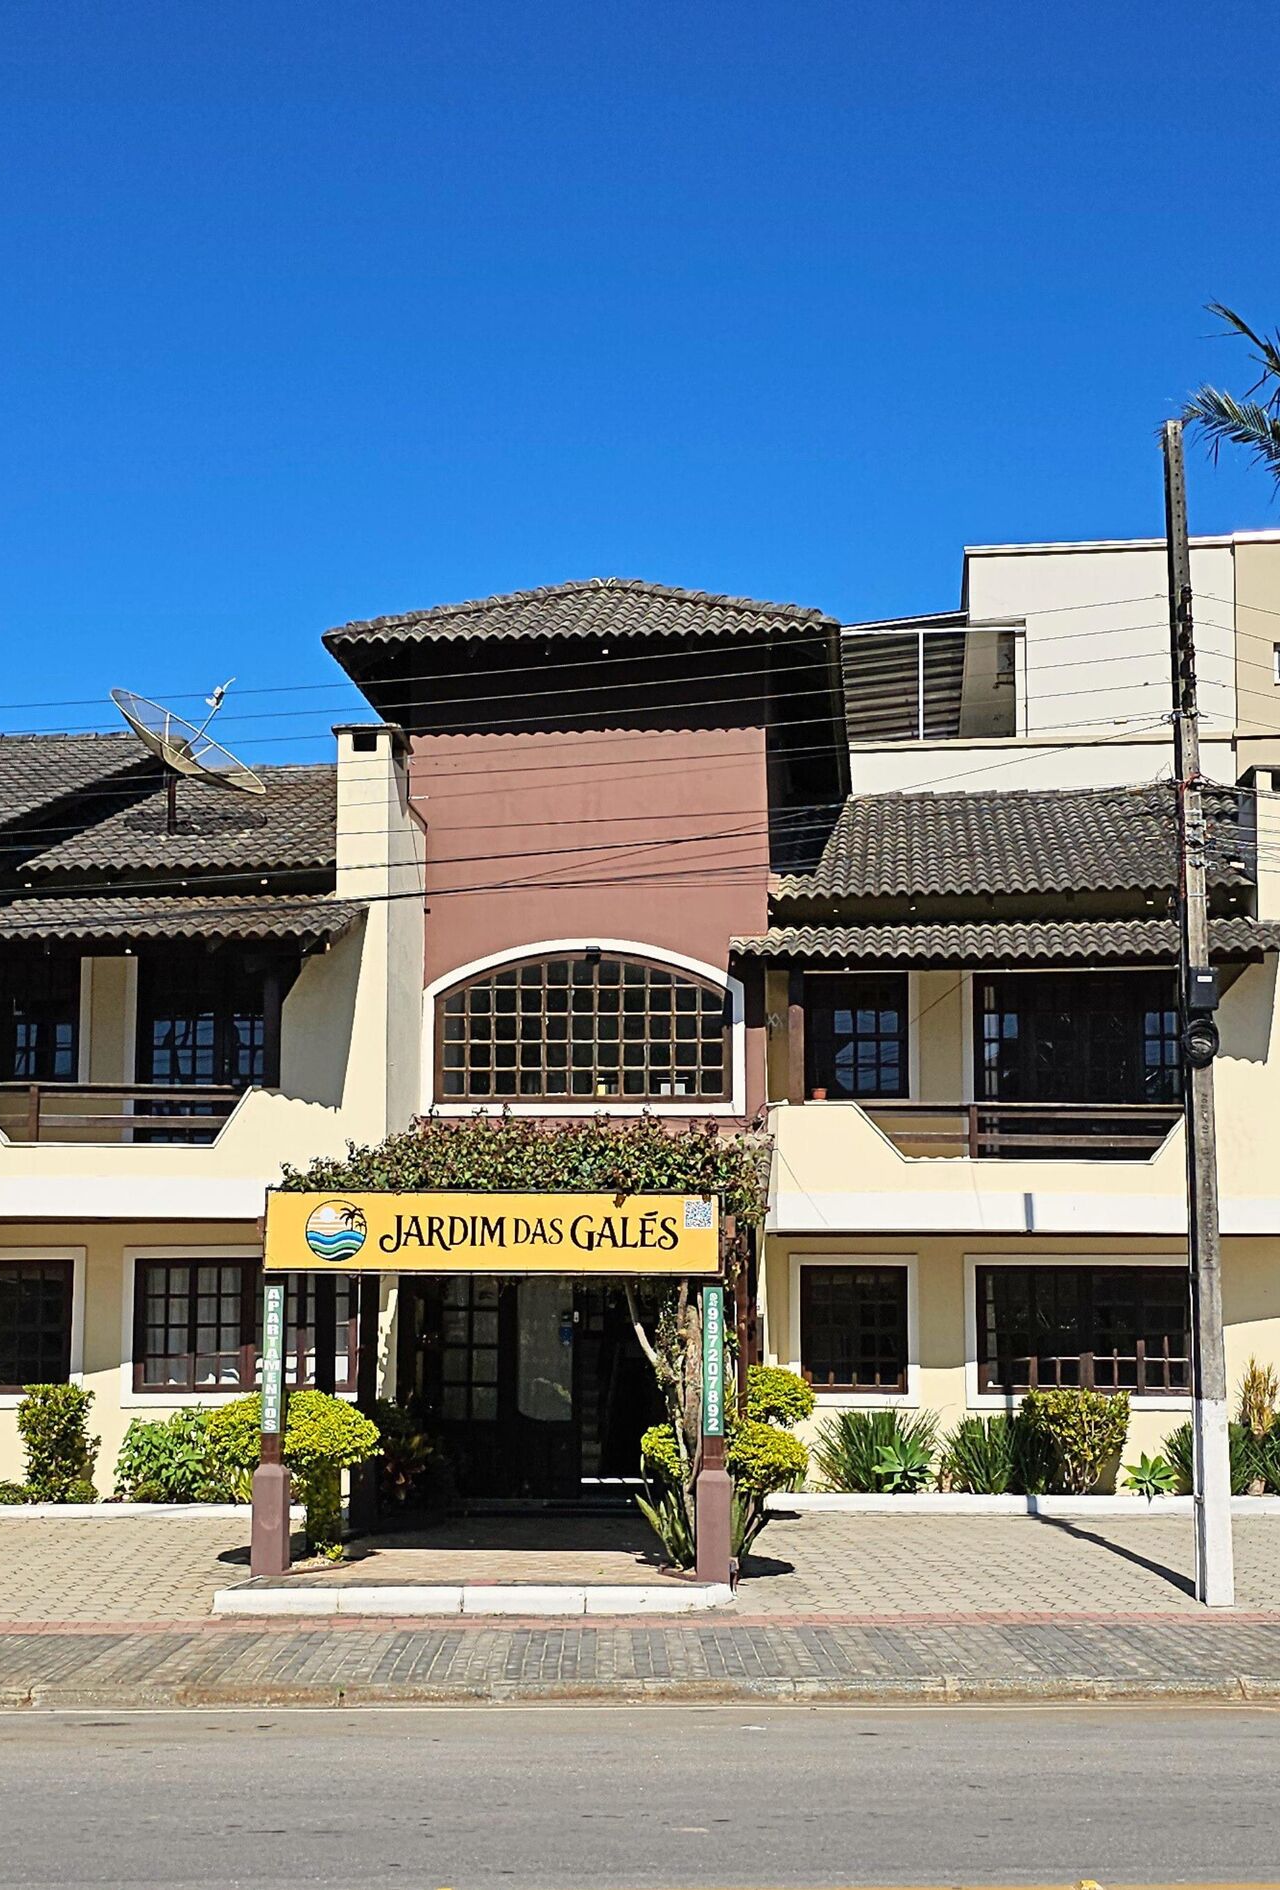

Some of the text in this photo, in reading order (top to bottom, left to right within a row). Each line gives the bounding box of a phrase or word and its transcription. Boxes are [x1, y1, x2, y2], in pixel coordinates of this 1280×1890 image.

[379, 1210, 679, 1252] JARDIM DAS GALÉS
[264, 1288, 280, 1431] APARTAMENTOS
[707, 1307, 719, 1432] 997207892
